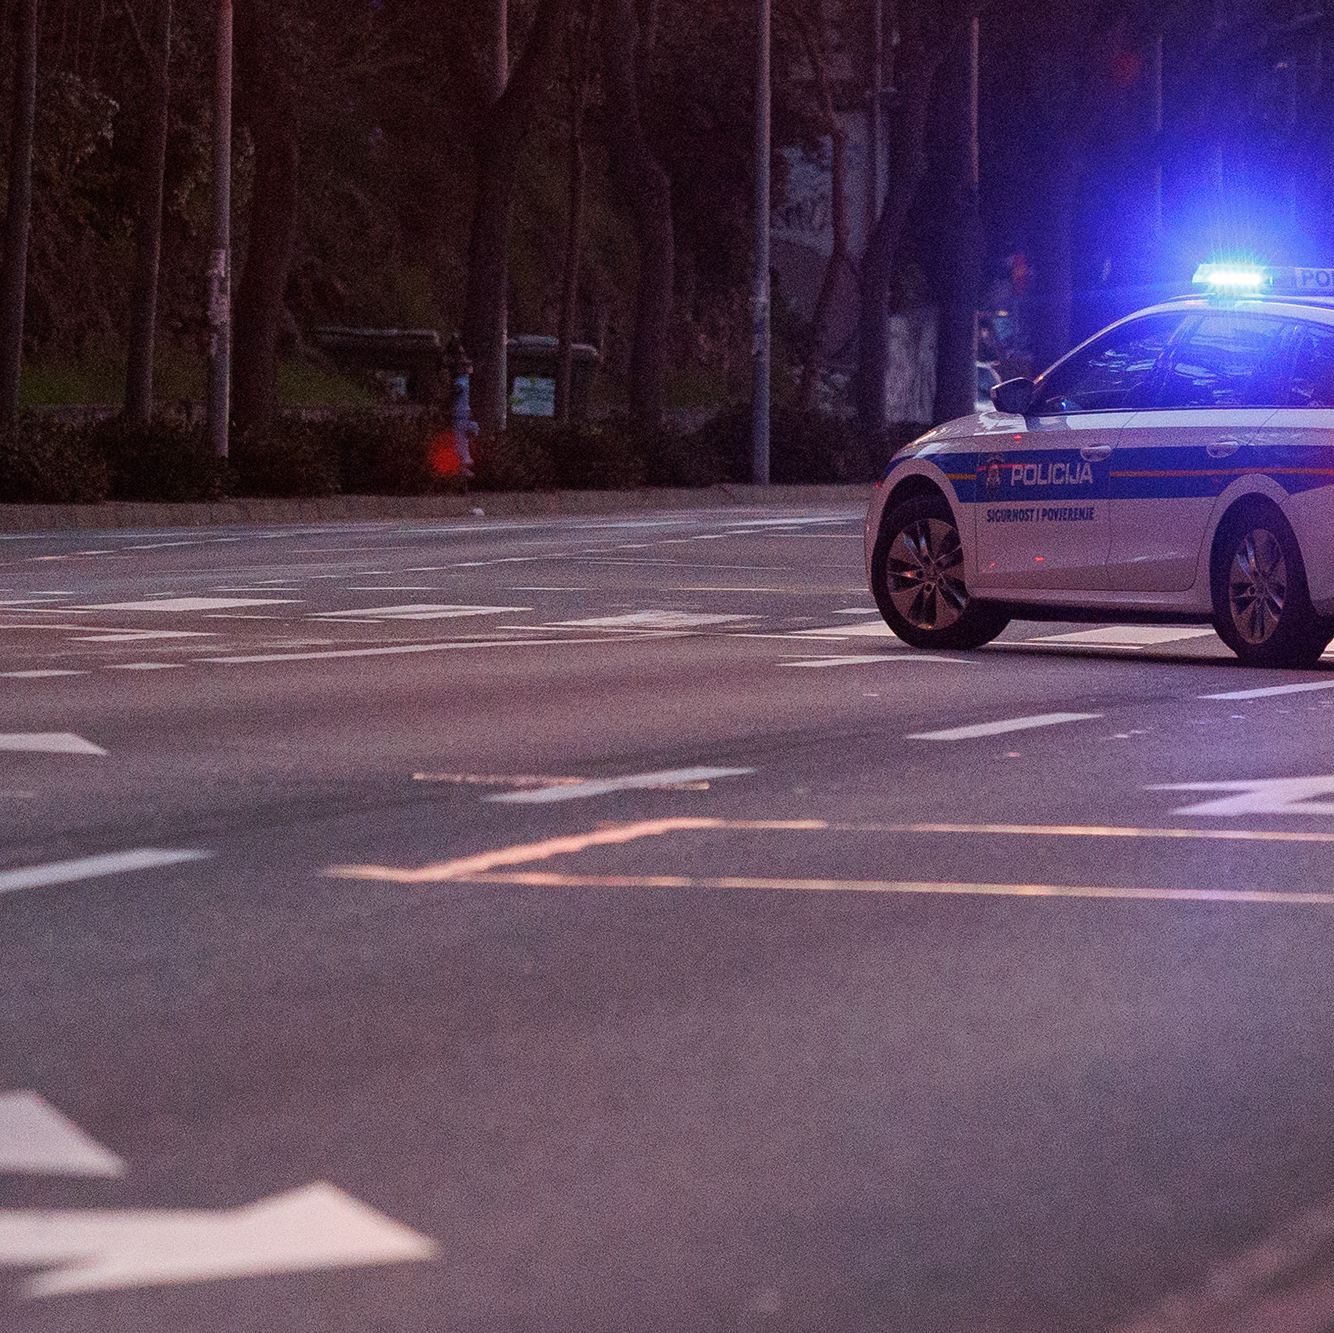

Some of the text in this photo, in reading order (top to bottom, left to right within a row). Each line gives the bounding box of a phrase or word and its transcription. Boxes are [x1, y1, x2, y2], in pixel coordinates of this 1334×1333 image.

[1010, 463, 1094, 486] POLICIJA
[987, 509, 1035, 523] SIGURNOST
[1042, 507, 1095, 522] POVJERENJE
